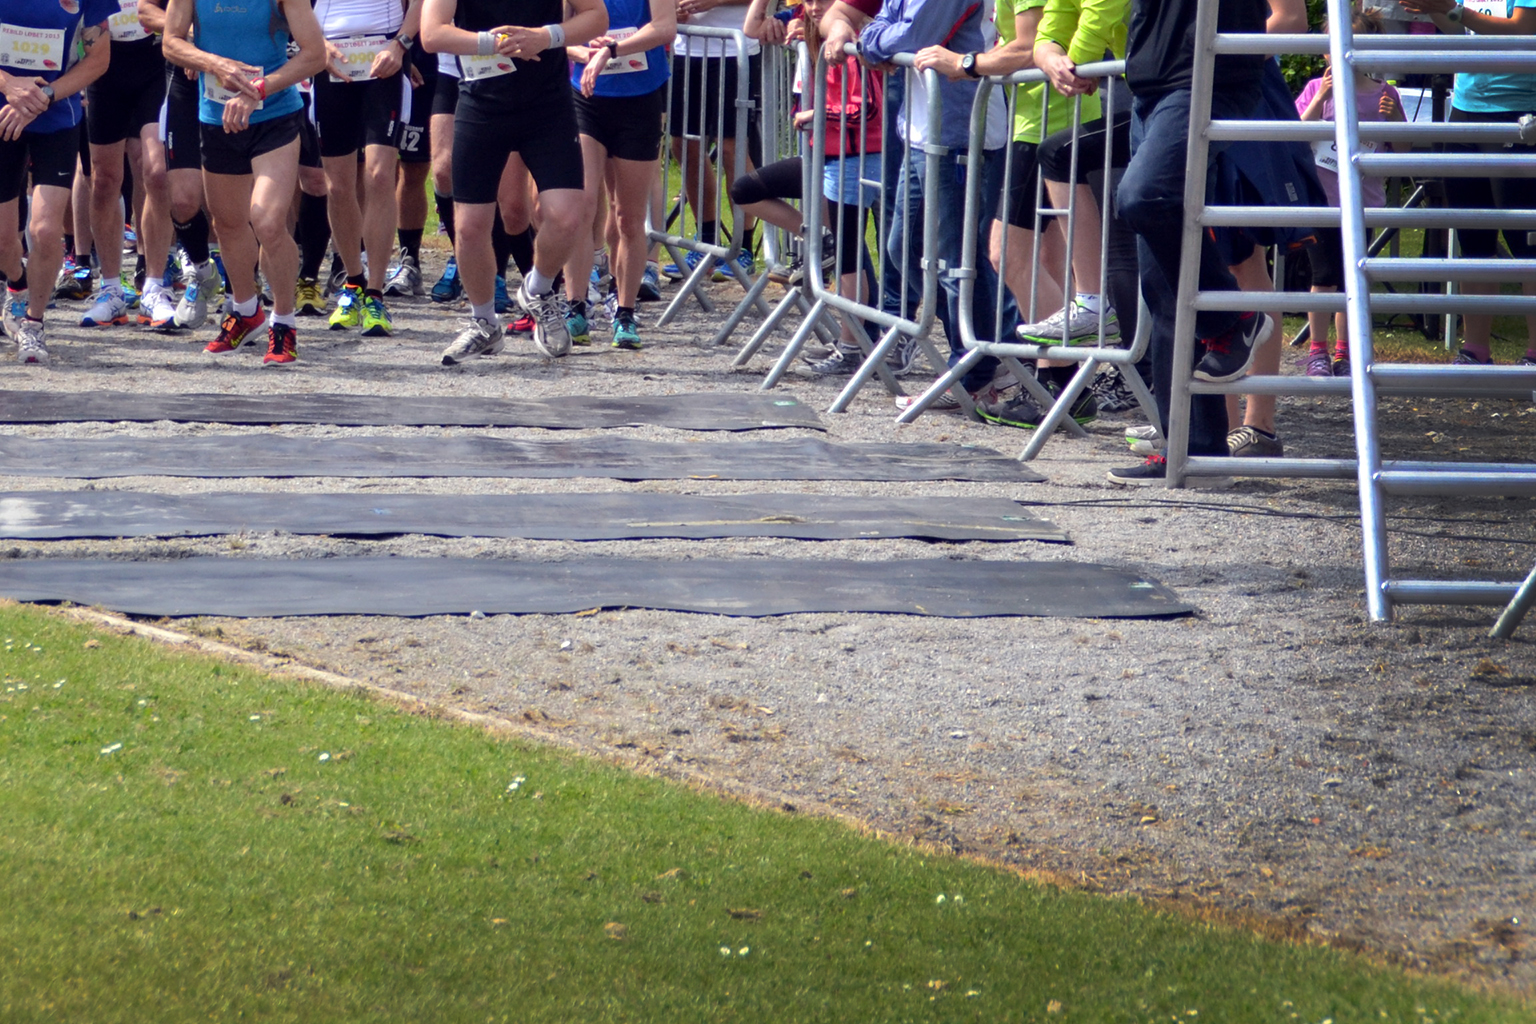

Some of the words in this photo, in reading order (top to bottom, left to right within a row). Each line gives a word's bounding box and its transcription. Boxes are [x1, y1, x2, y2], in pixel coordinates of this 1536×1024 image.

[112, 12, 139, 26] 106
[2, 27, 24, 36] REBILD
[12, 40, 51, 55] 1029
[349, 51, 376, 64] 090
[400, 129, 421, 152] 42
